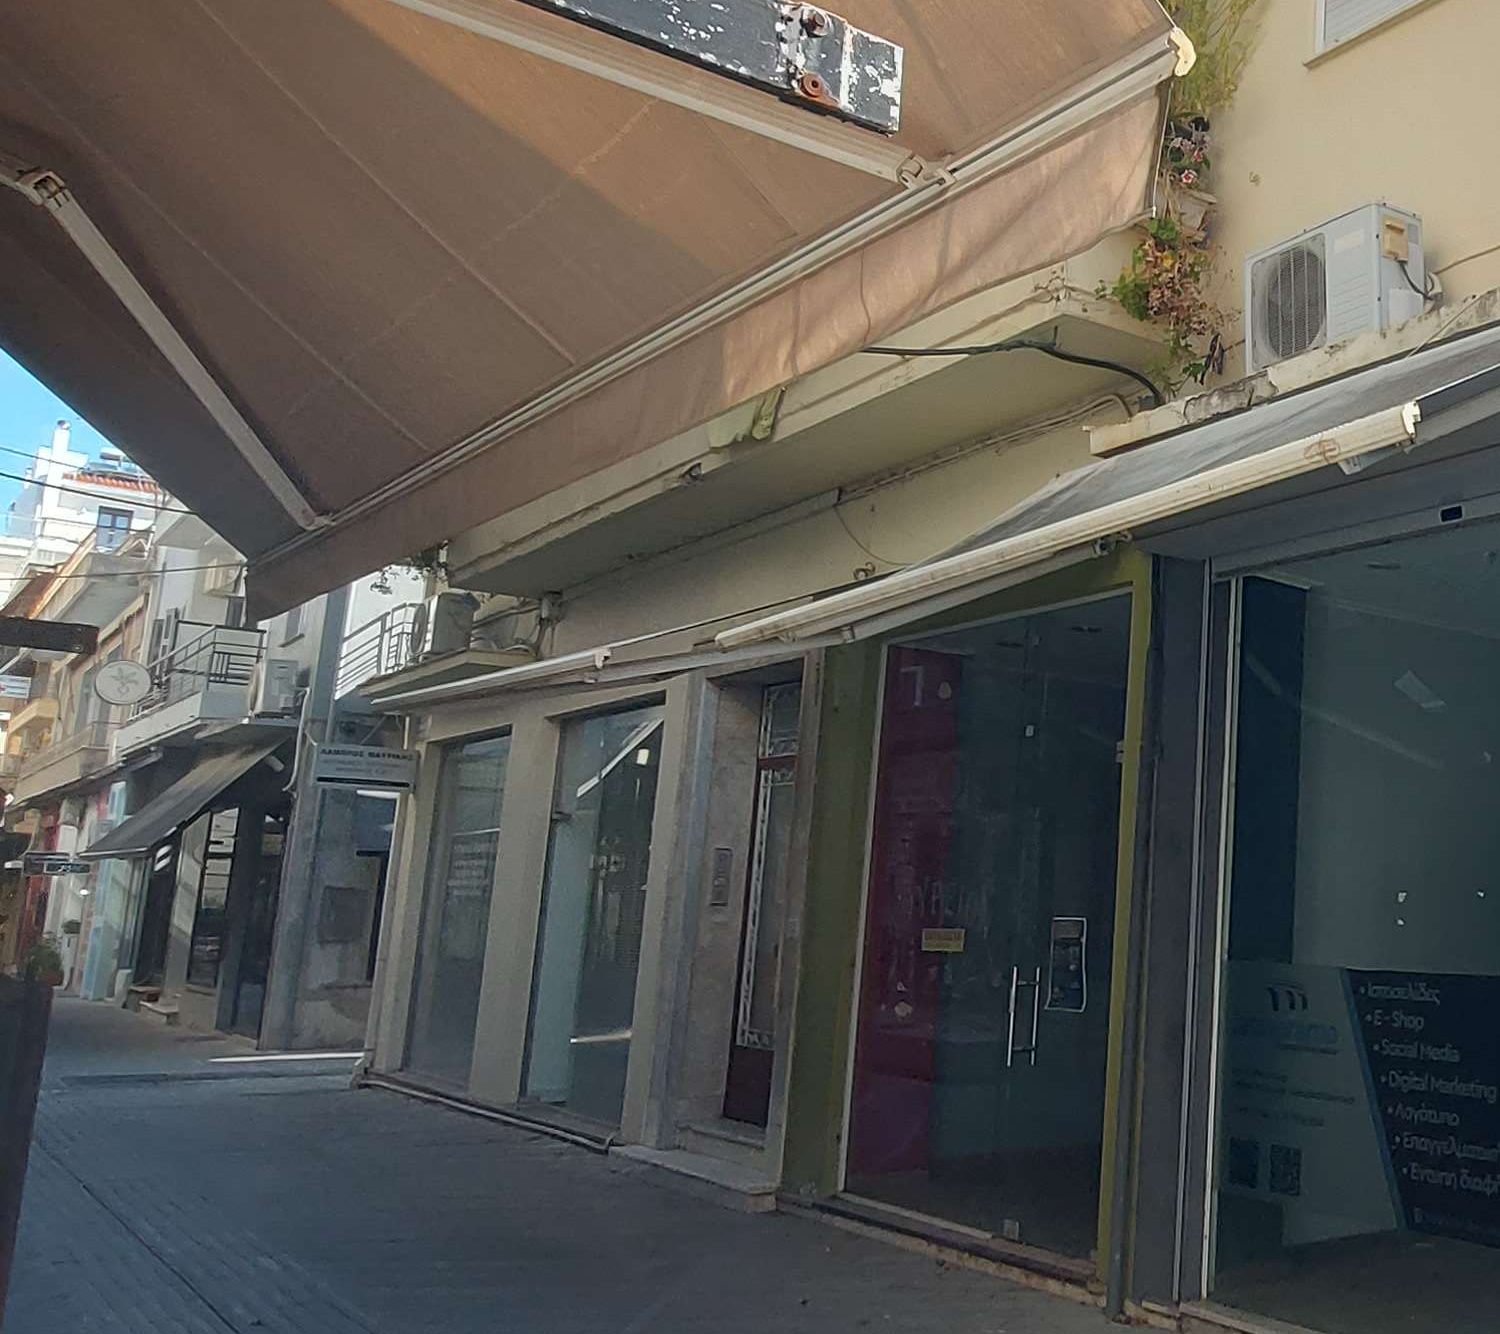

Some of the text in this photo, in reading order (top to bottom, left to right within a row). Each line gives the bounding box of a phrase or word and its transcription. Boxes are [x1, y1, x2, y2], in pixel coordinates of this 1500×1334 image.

[1381, 1038, 1461, 1064] Social Media
[1388, 1070, 1497, 1104] Digital Marketing
